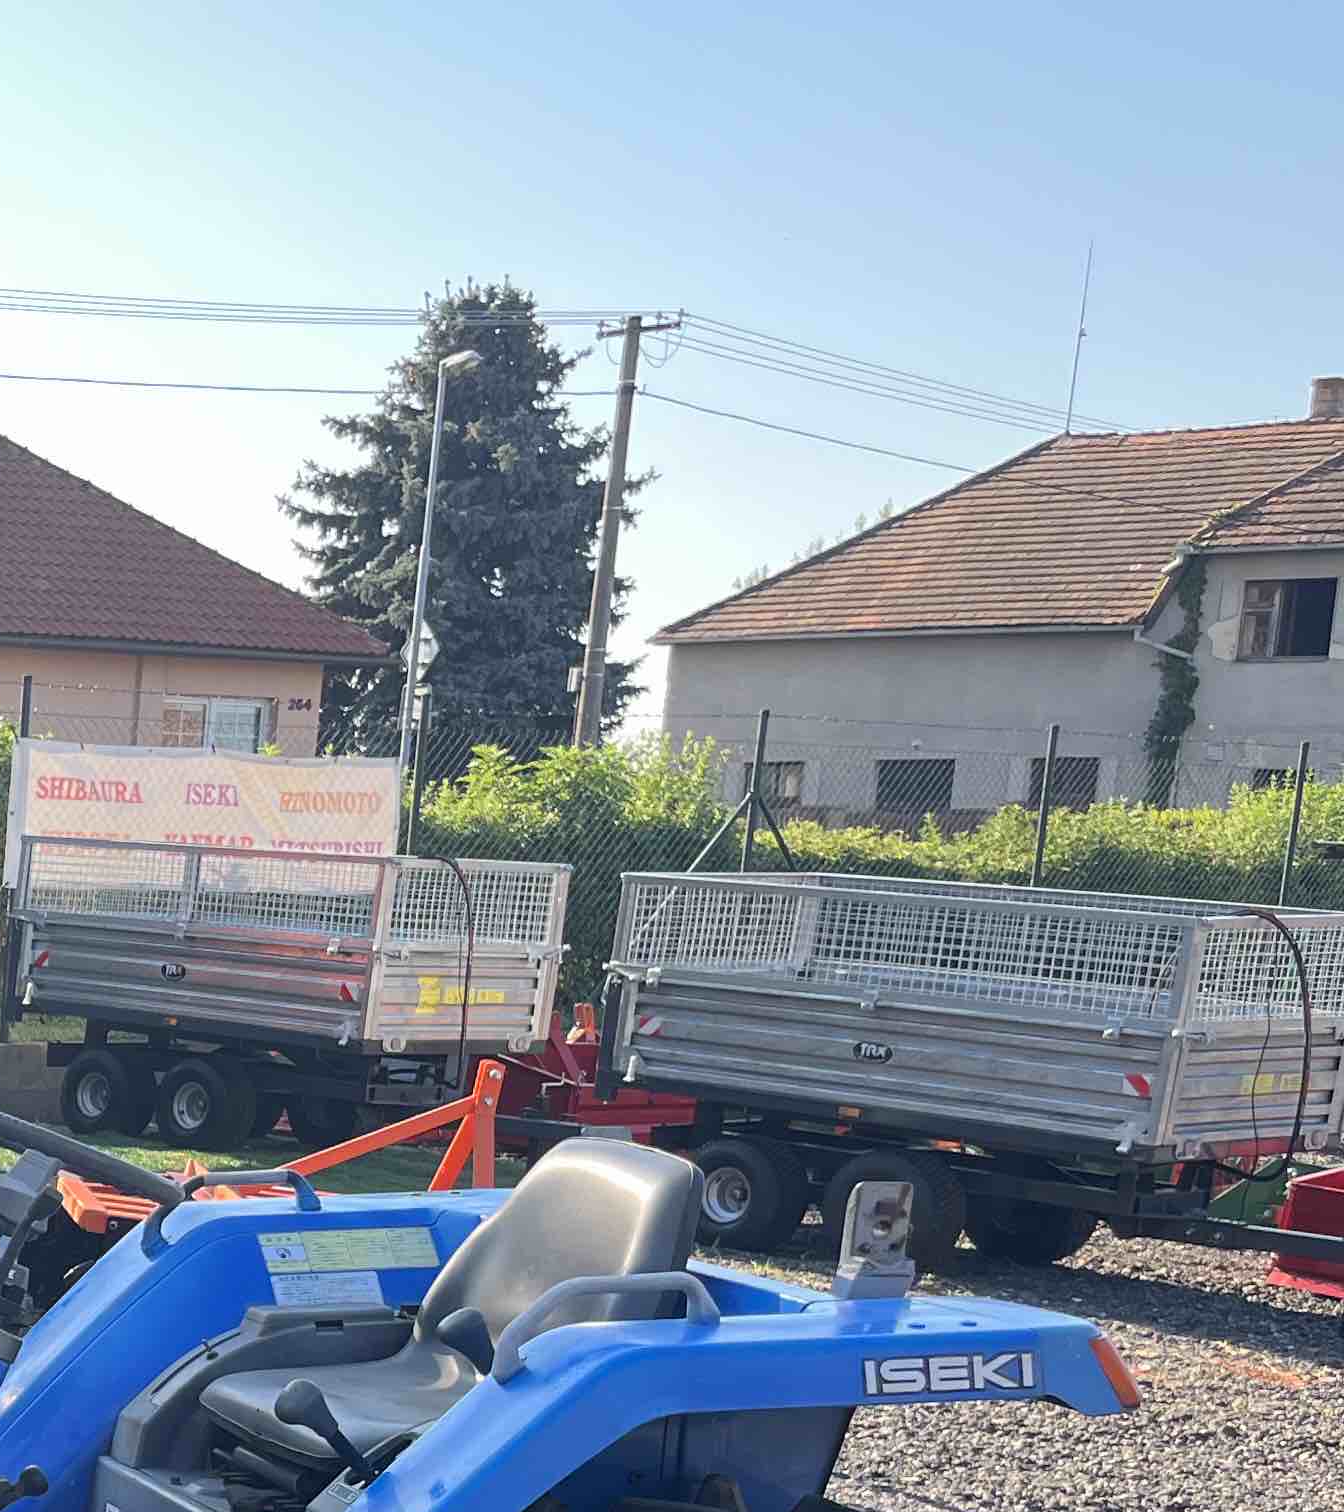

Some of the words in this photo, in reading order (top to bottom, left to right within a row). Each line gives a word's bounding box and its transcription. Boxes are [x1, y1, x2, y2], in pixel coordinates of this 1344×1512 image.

[36, 776, 144, 804] SHIBAURA
[185, 783, 240, 807] ISEKI
[864, 1352, 1034, 1395] ISEKI
